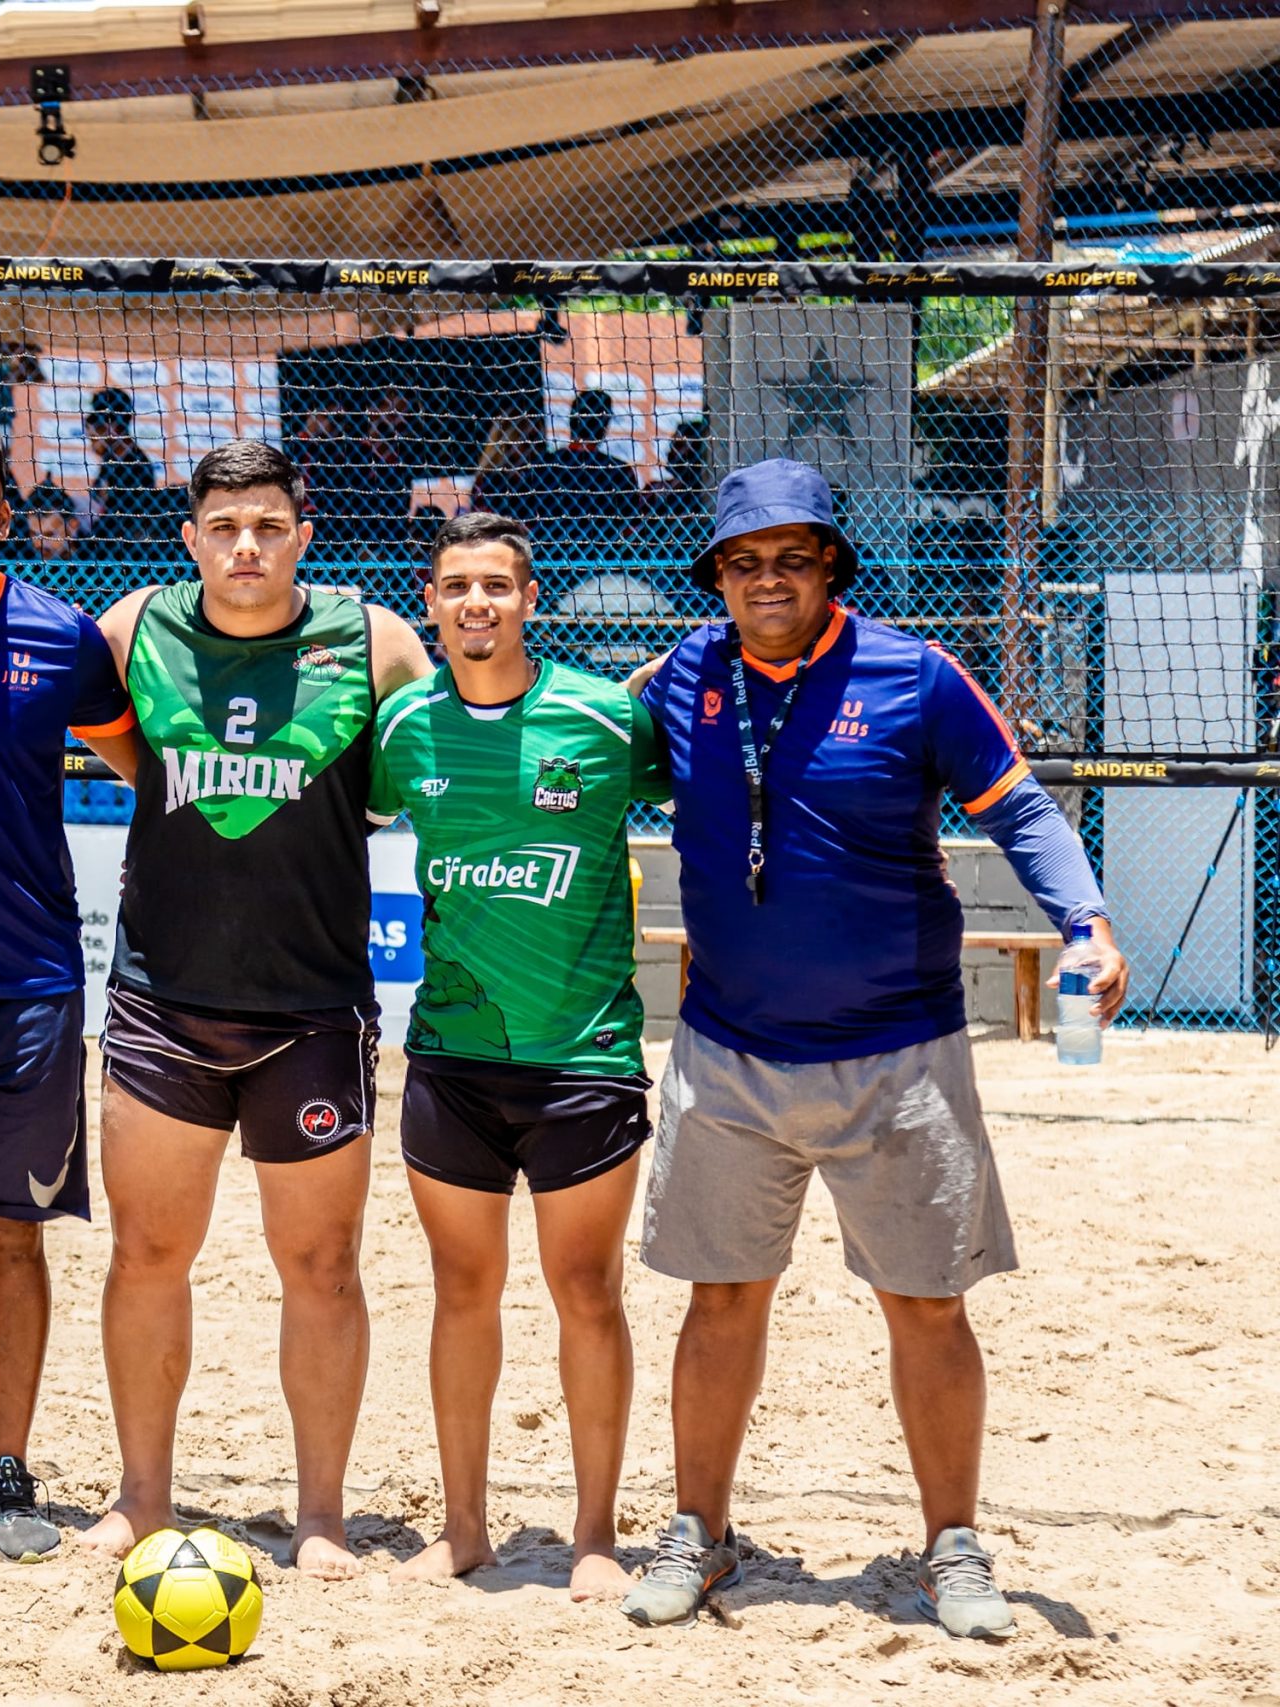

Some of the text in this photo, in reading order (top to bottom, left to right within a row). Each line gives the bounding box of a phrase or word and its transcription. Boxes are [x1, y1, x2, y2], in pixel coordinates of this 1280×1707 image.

[339, 269, 429, 285] SANDEVER
[688, 272, 779, 287] SANDEVER
[1045, 271, 1137, 287] SANDEVER
[1, 670, 38, 685] JUBS
[224, 696, 258, 744] 2
[828, 720, 869, 737] JUBS
[1072, 763, 1167, 778] SANDEVER
[162, 747, 305, 815] MIRON
[421, 778, 450, 792] STY
[535, 786, 578, 809] CACTUS
[427, 855, 541, 892] Cifrabet
